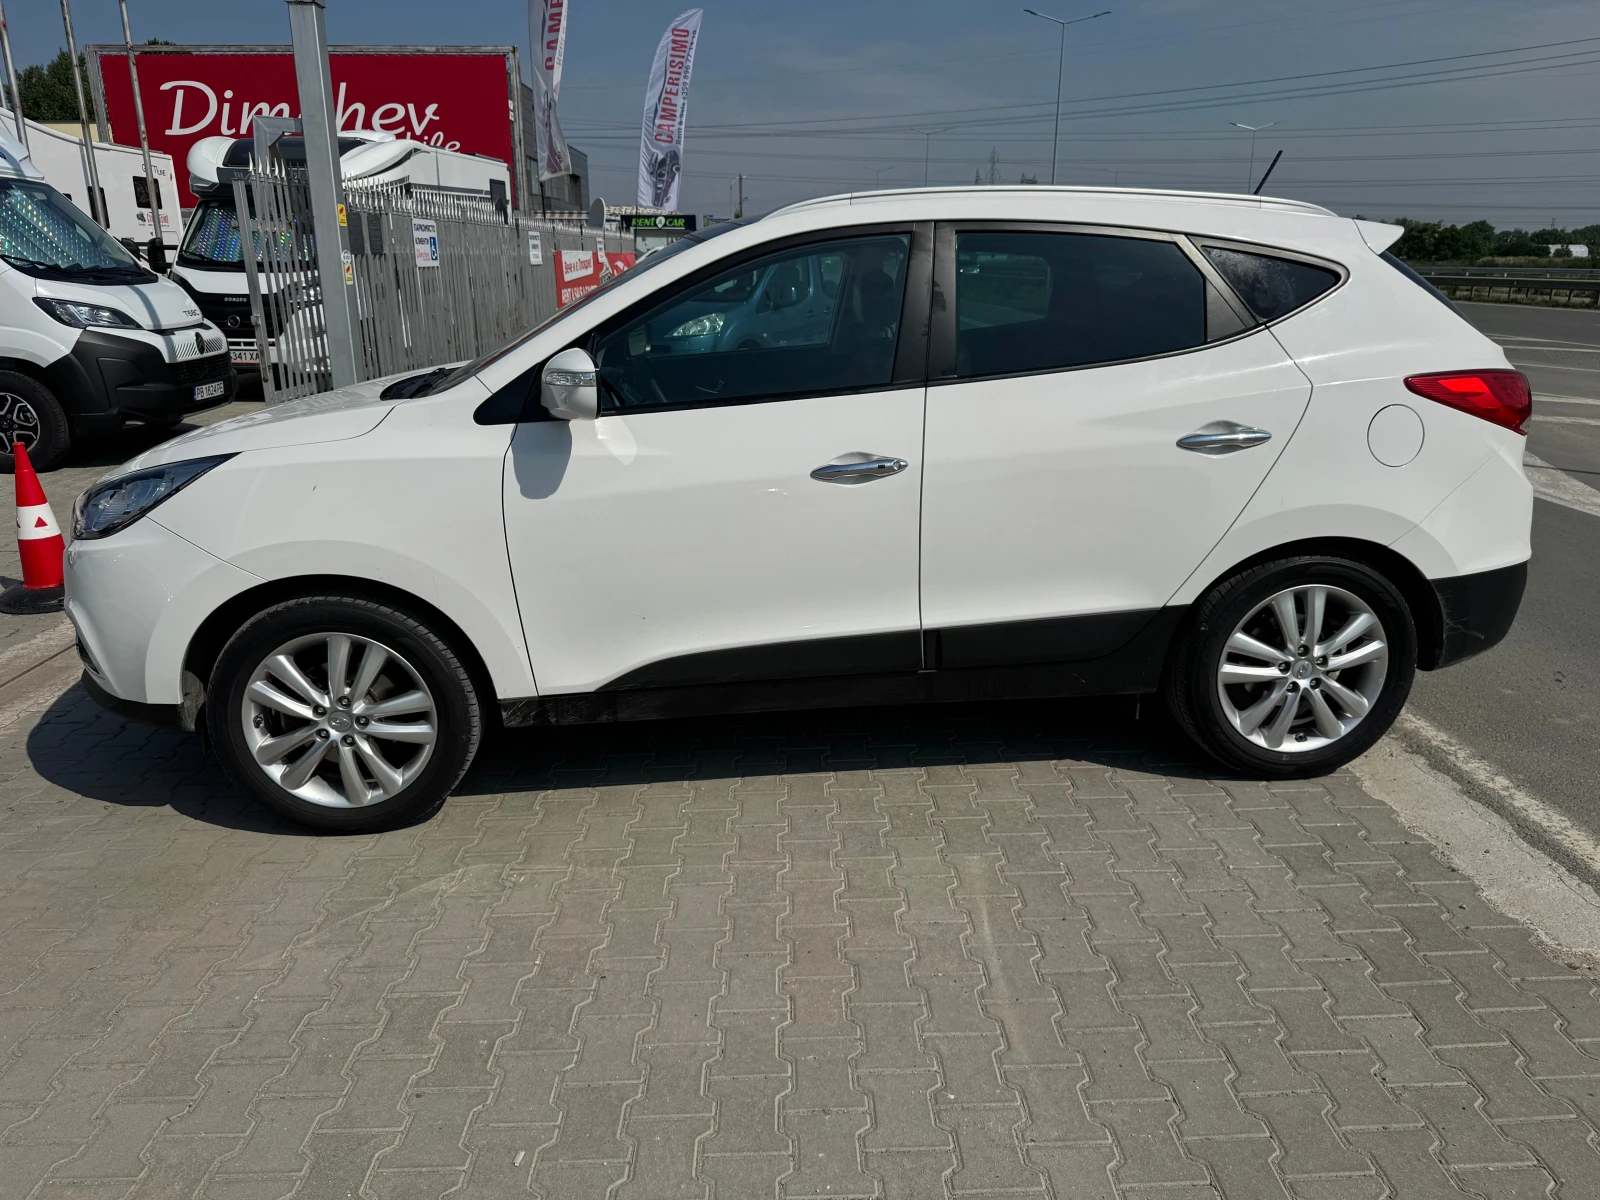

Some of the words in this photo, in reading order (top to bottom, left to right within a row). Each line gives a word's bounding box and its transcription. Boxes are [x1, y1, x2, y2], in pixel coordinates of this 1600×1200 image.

[160, 80, 440, 136] Dimhev
[654, 28, 690, 144] CAMPERISIMO
[666, 217, 685, 227] CAR
